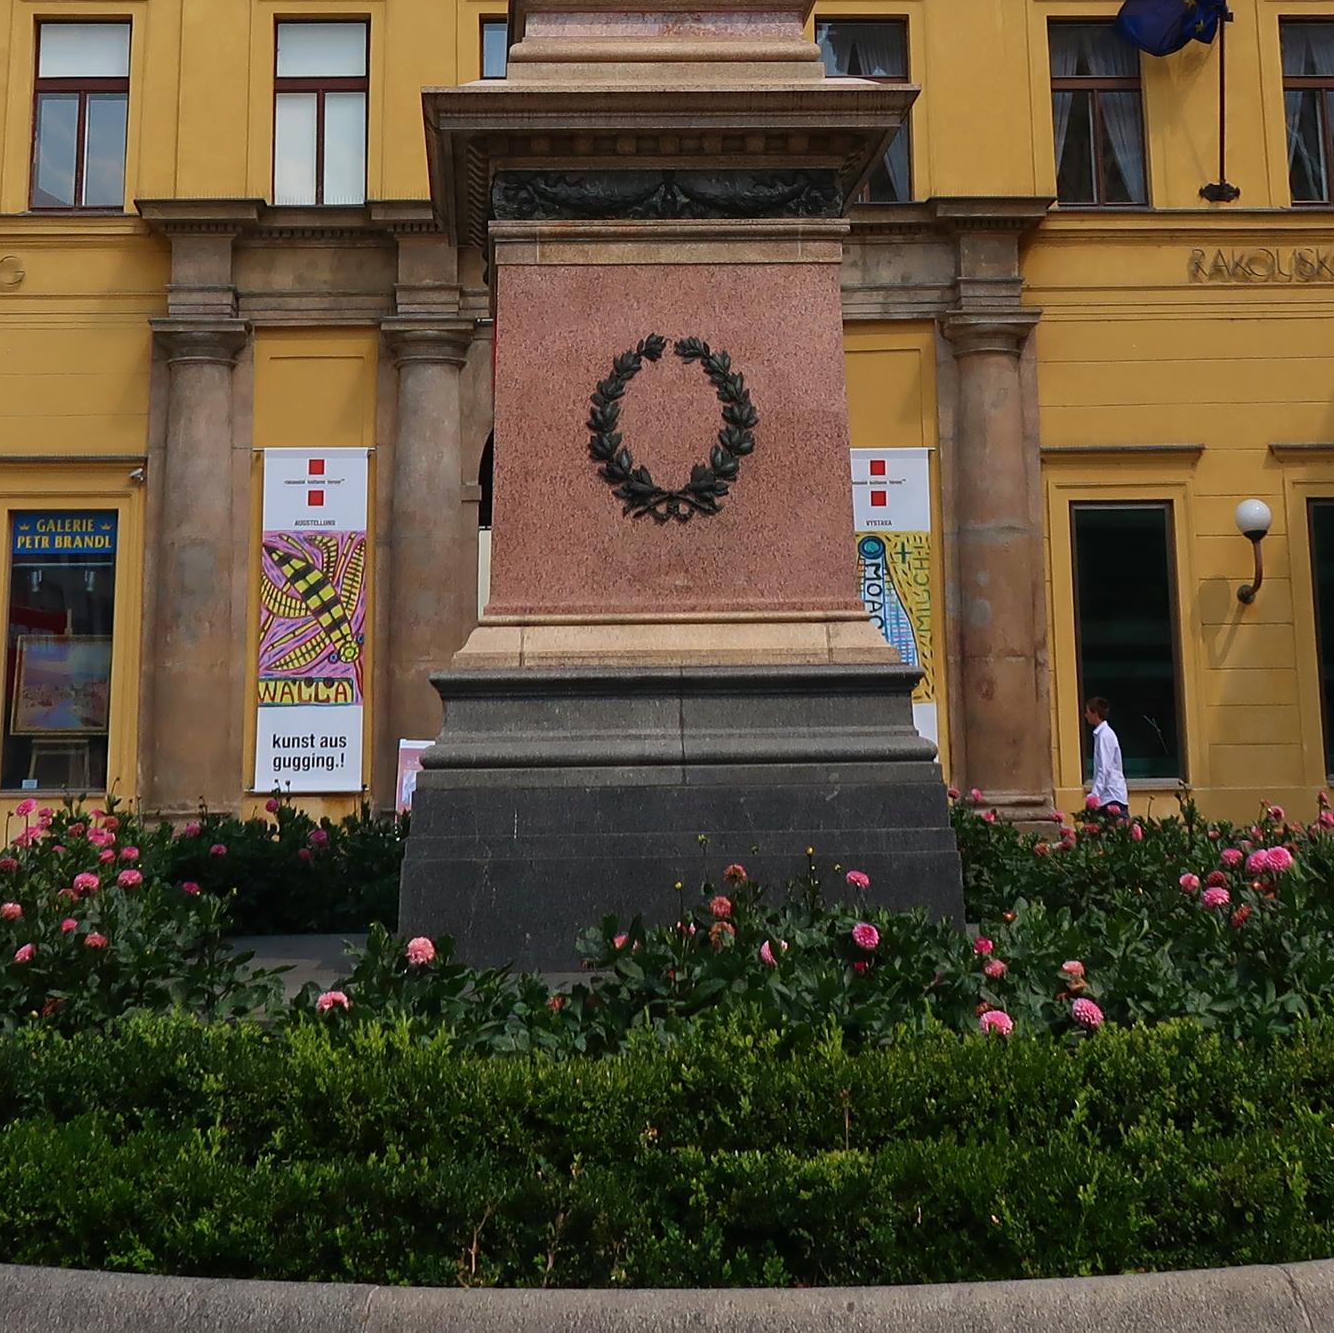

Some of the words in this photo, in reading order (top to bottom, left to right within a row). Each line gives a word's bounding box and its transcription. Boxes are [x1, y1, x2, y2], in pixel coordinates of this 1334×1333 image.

[36, 518, 95, 532] GALERIE
[17, 535, 49, 549] PETR
[54, 535, 112, 548] BRANDL
[258, 680, 348, 704] WALLA
[272, 733, 315, 748] kunst
[319, 735, 347, 748] aus
[272, 752, 345, 771] gugging.!
